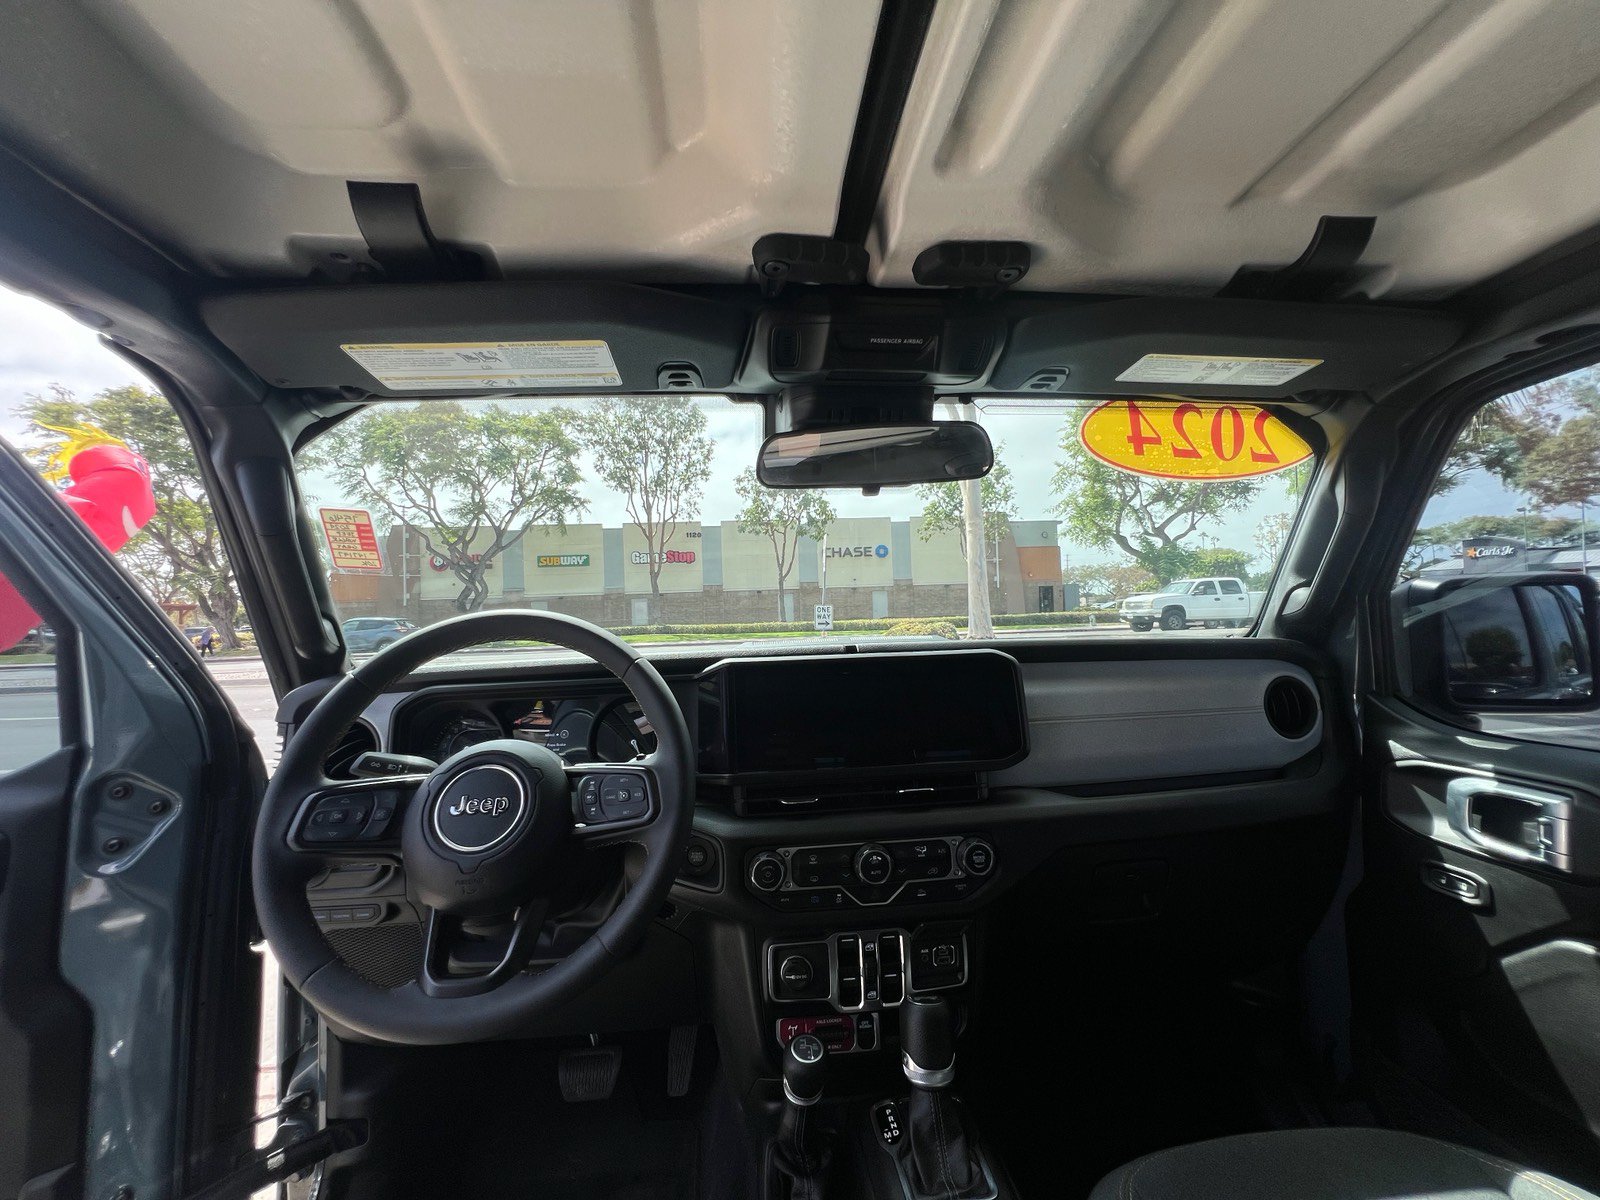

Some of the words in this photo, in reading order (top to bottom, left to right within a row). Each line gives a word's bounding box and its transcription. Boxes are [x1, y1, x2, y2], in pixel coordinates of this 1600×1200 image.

[903, 337, 924, 345] AIRBAG
[631, 550, 696, 564] GameStop
[822, 546, 873, 558] CHASE
[539, 555, 588, 566] SUBWAY
[450, 795, 509, 816] Jeep
[890, 1121, 897, 1129] N
[883, 1131, 892, 1139] M
